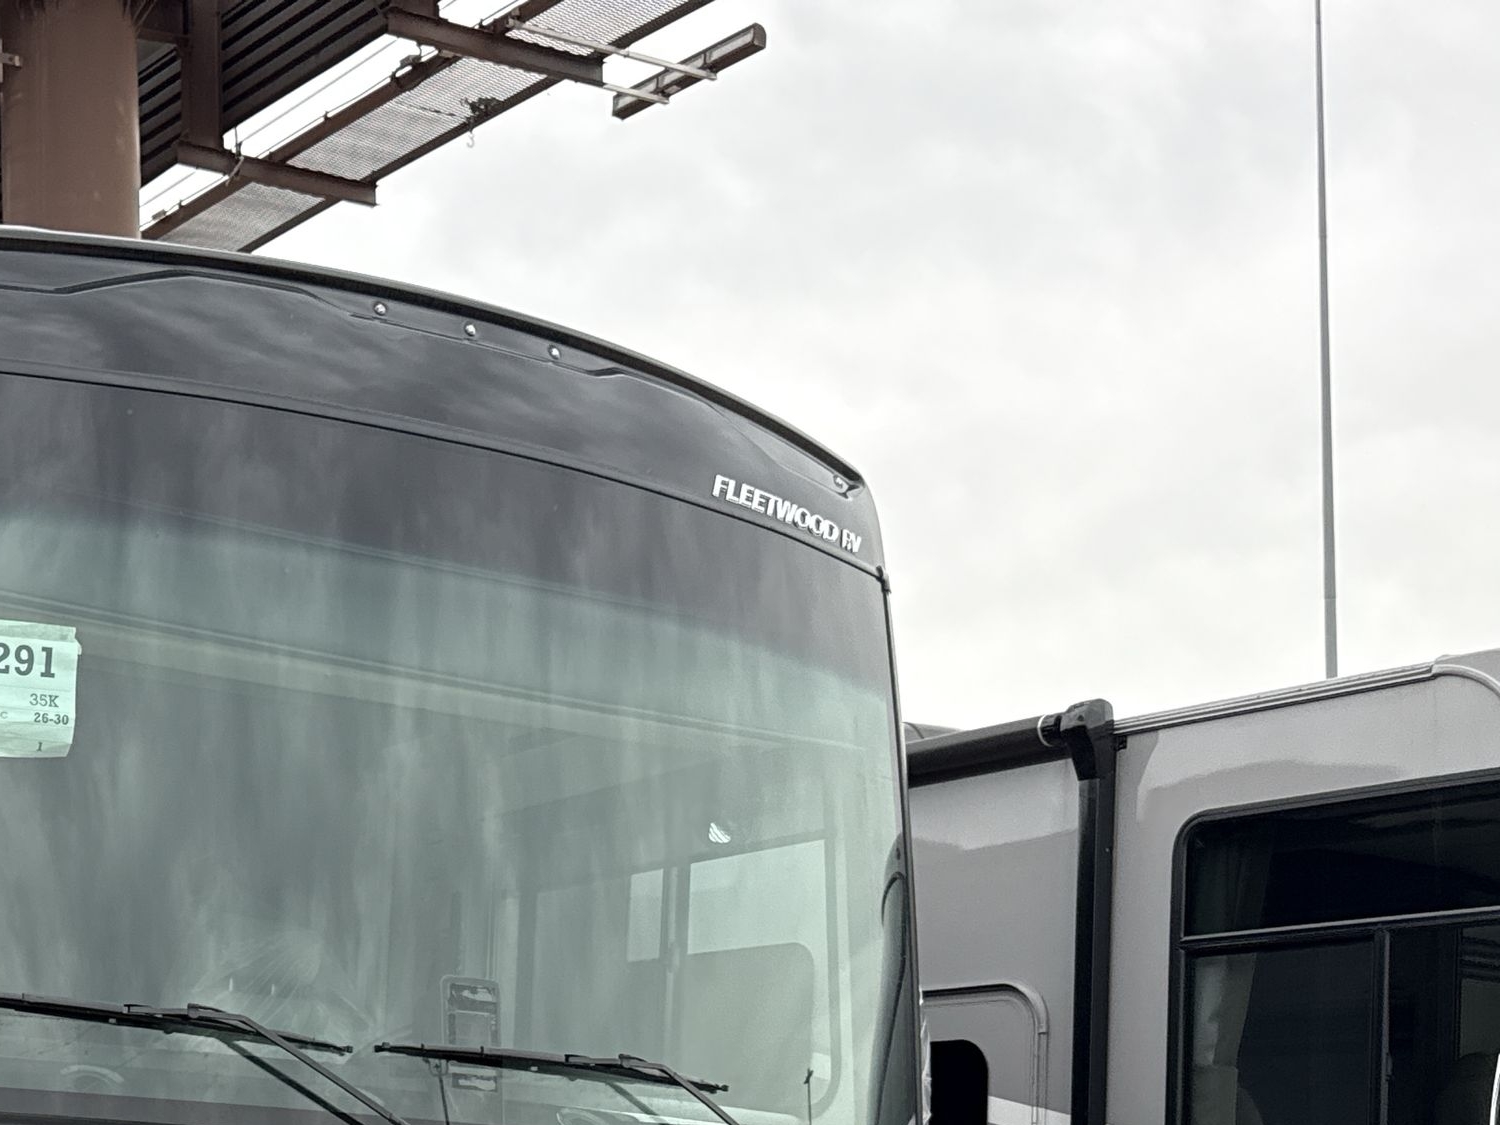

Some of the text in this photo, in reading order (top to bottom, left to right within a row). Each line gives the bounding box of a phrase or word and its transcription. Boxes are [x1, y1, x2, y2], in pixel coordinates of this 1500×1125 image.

[712, 474, 862, 553] FLEETWOOD RV
[29, 693, 60, 708] 35K
[33, 712, 69, 725] 26-30
